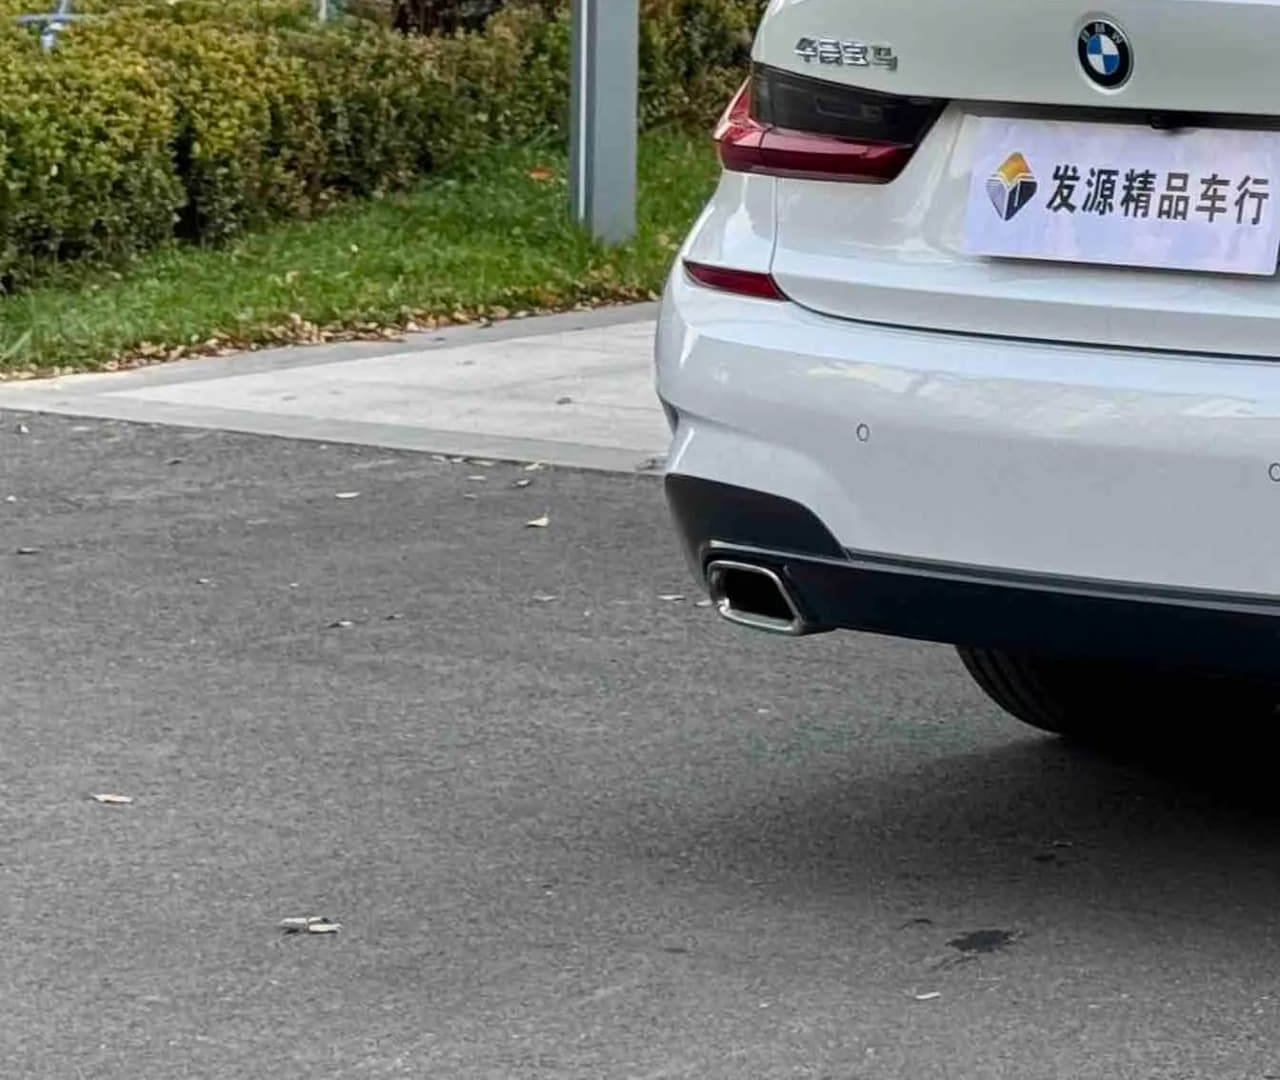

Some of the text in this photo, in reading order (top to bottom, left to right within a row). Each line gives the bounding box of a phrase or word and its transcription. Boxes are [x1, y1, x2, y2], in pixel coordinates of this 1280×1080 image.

[1046, 164, 1269, 224] 发源精品车行
